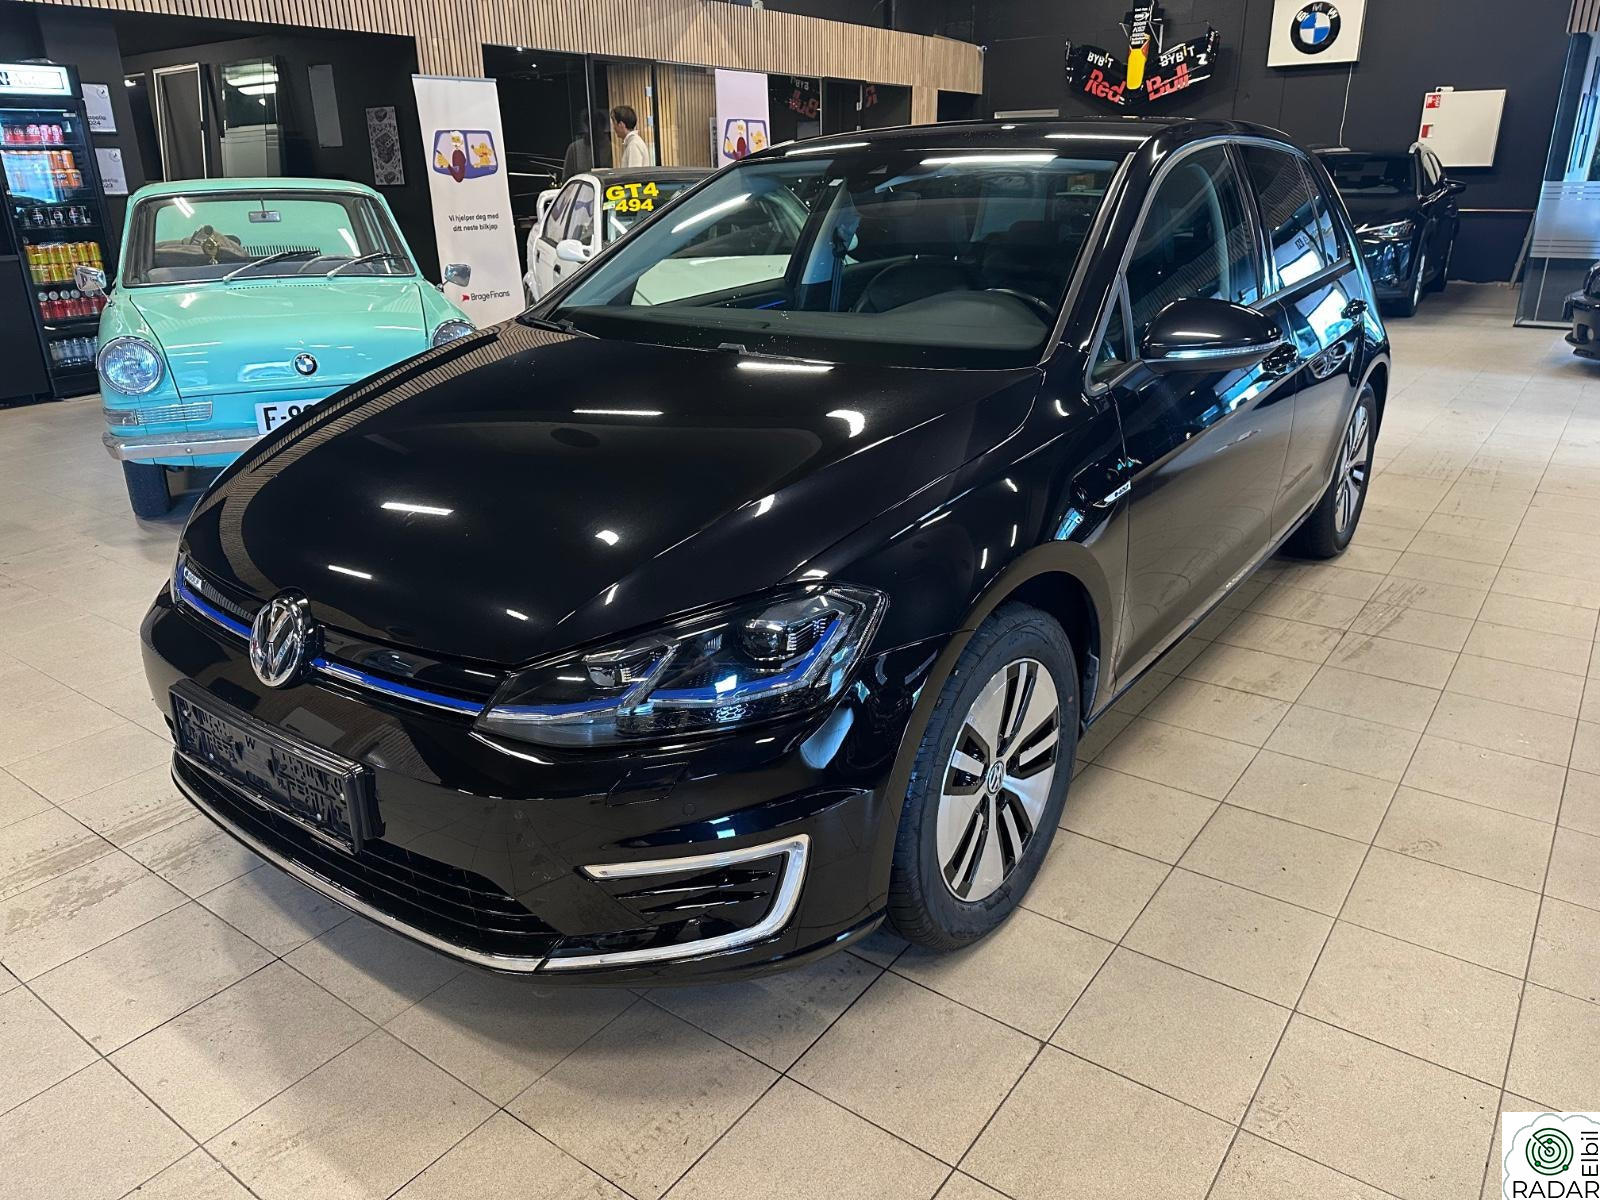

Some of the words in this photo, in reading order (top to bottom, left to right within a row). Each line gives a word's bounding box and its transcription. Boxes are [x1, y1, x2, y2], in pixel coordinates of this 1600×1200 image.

[1296, 3, 1338, 22] BMW
[1084, 68, 1127, 104] Red
[1145, 63, 1189, 101] Bull
[605, 181, 660, 201] GT4
[614, 198, 655, 212] 494
[455, 214, 475, 223] hjelper
[475, 213, 487, 221] deg
[452, 224, 462, 232] ditt
